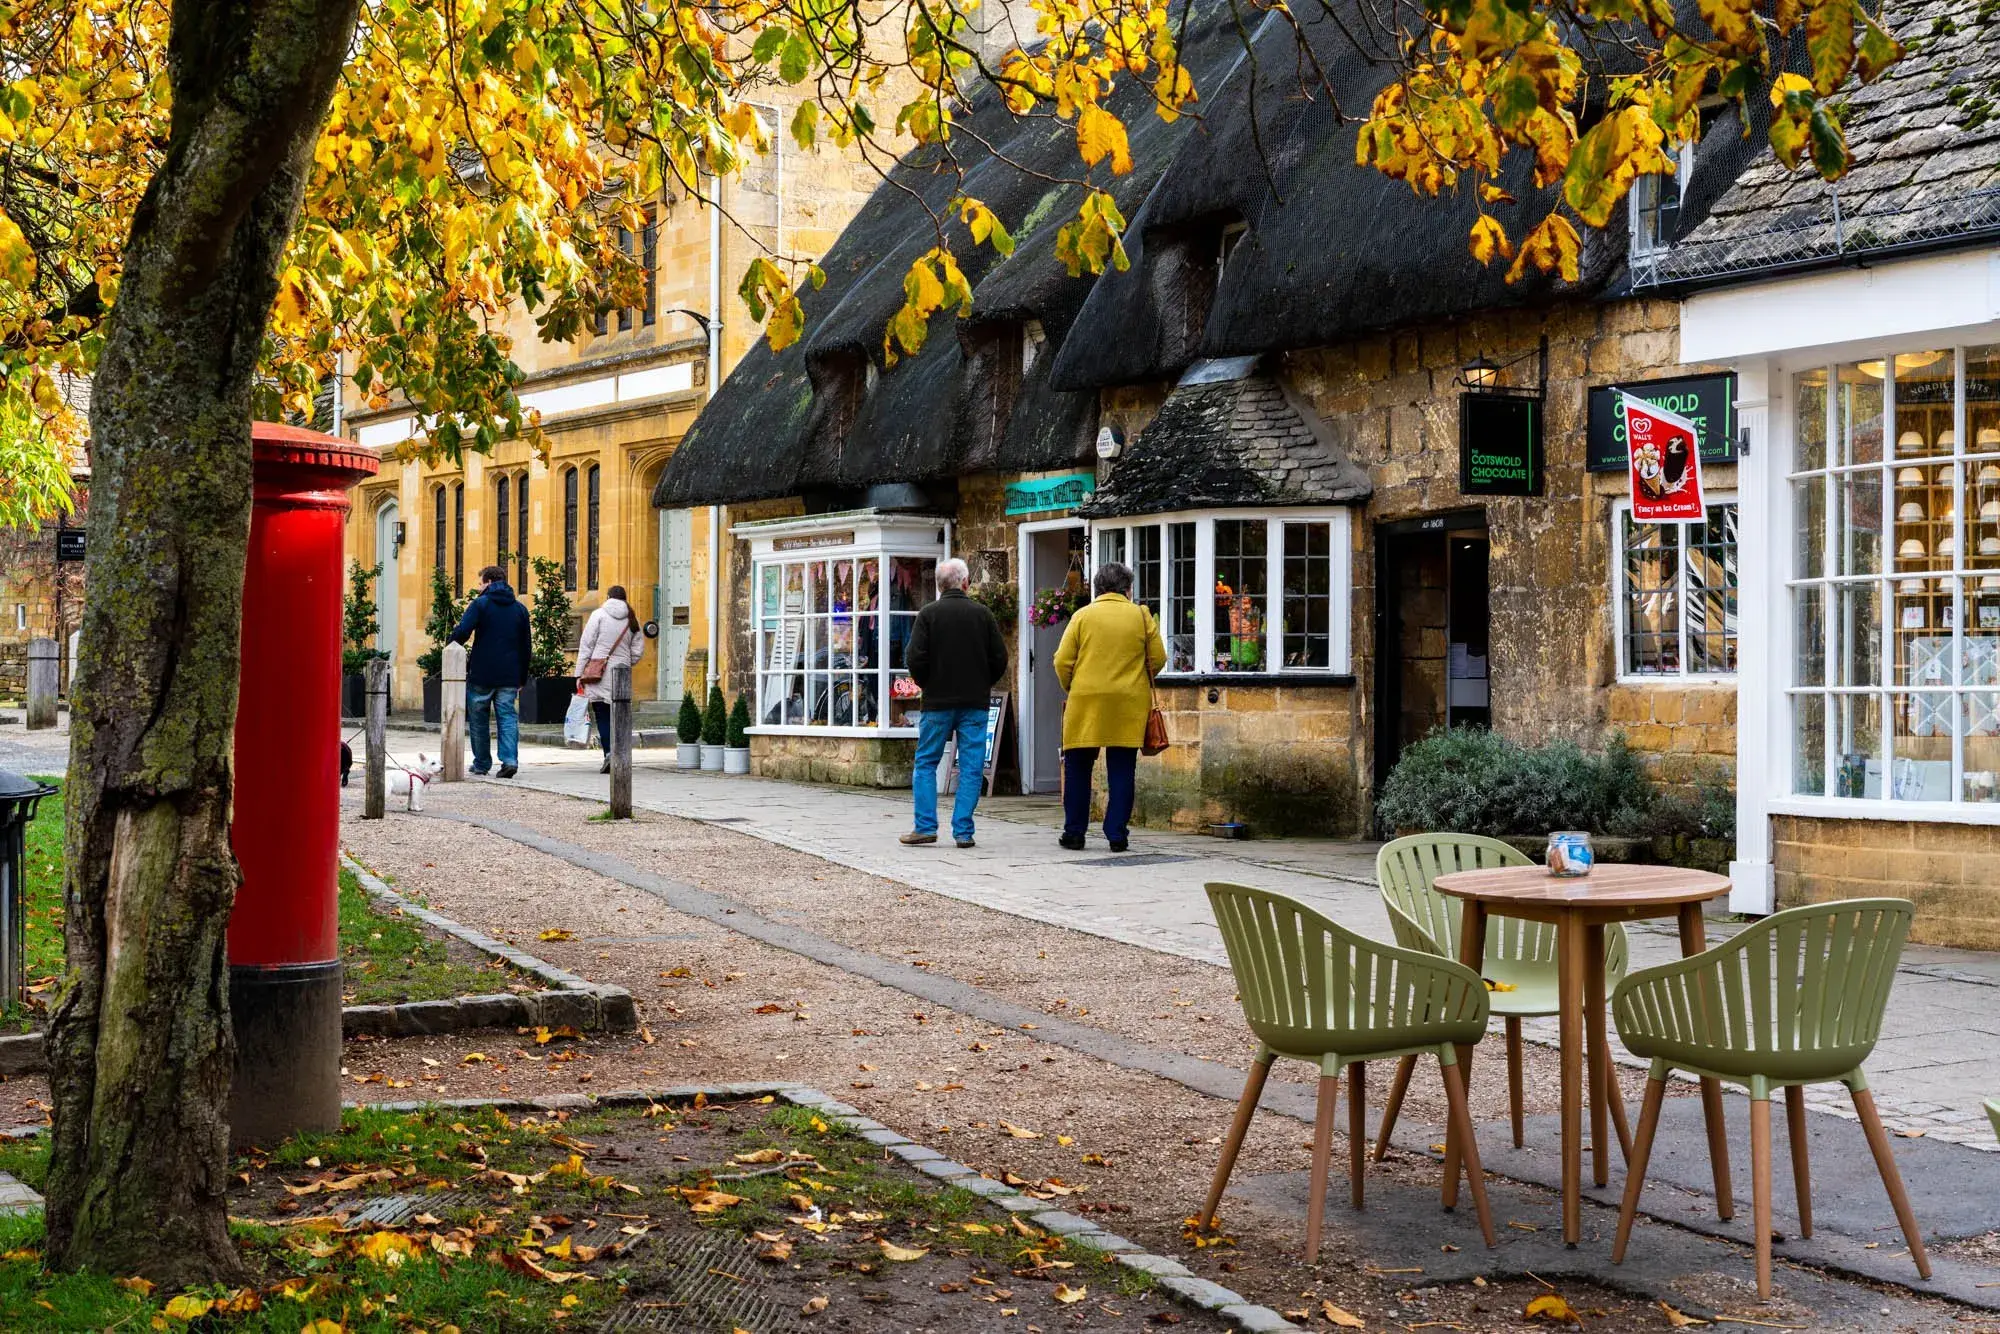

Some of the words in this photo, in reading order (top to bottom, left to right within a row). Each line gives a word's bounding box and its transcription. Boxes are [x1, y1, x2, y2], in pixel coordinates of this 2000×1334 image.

[1910, 381, 1950, 395] NORDIC
[1471, 454, 1522, 466] COTSWOLD
[1471, 467, 1527, 480] CHOCOLATE
[1638, 505, 1654, 516] Fancy
[1663, 504, 1672, 512] Ice
[1673, 503, 1695, 512] Cream?
